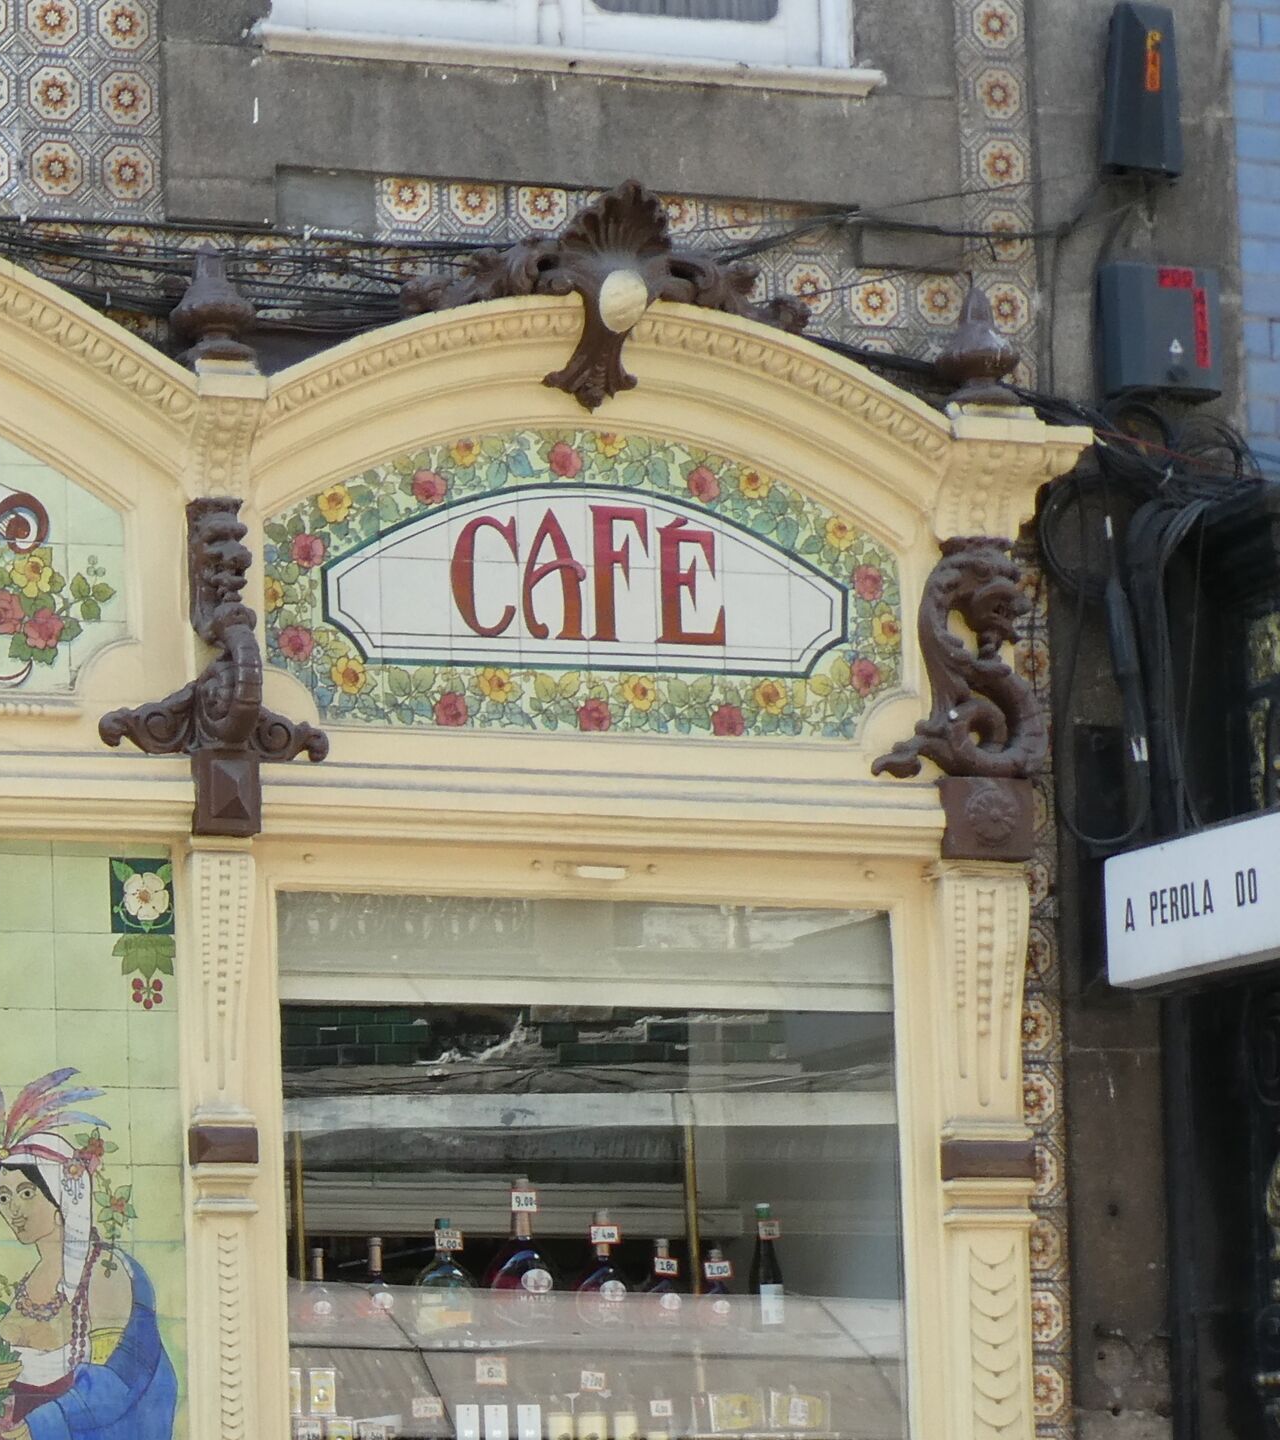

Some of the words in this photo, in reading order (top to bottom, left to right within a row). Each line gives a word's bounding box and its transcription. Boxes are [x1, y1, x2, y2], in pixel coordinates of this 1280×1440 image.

[449, 504, 727, 647] CAFÉ
[1125, 897, 1135, 932] A
[1149, 878, 1215, 927] PEROLA
[1235, 867, 1258, 907] DO
